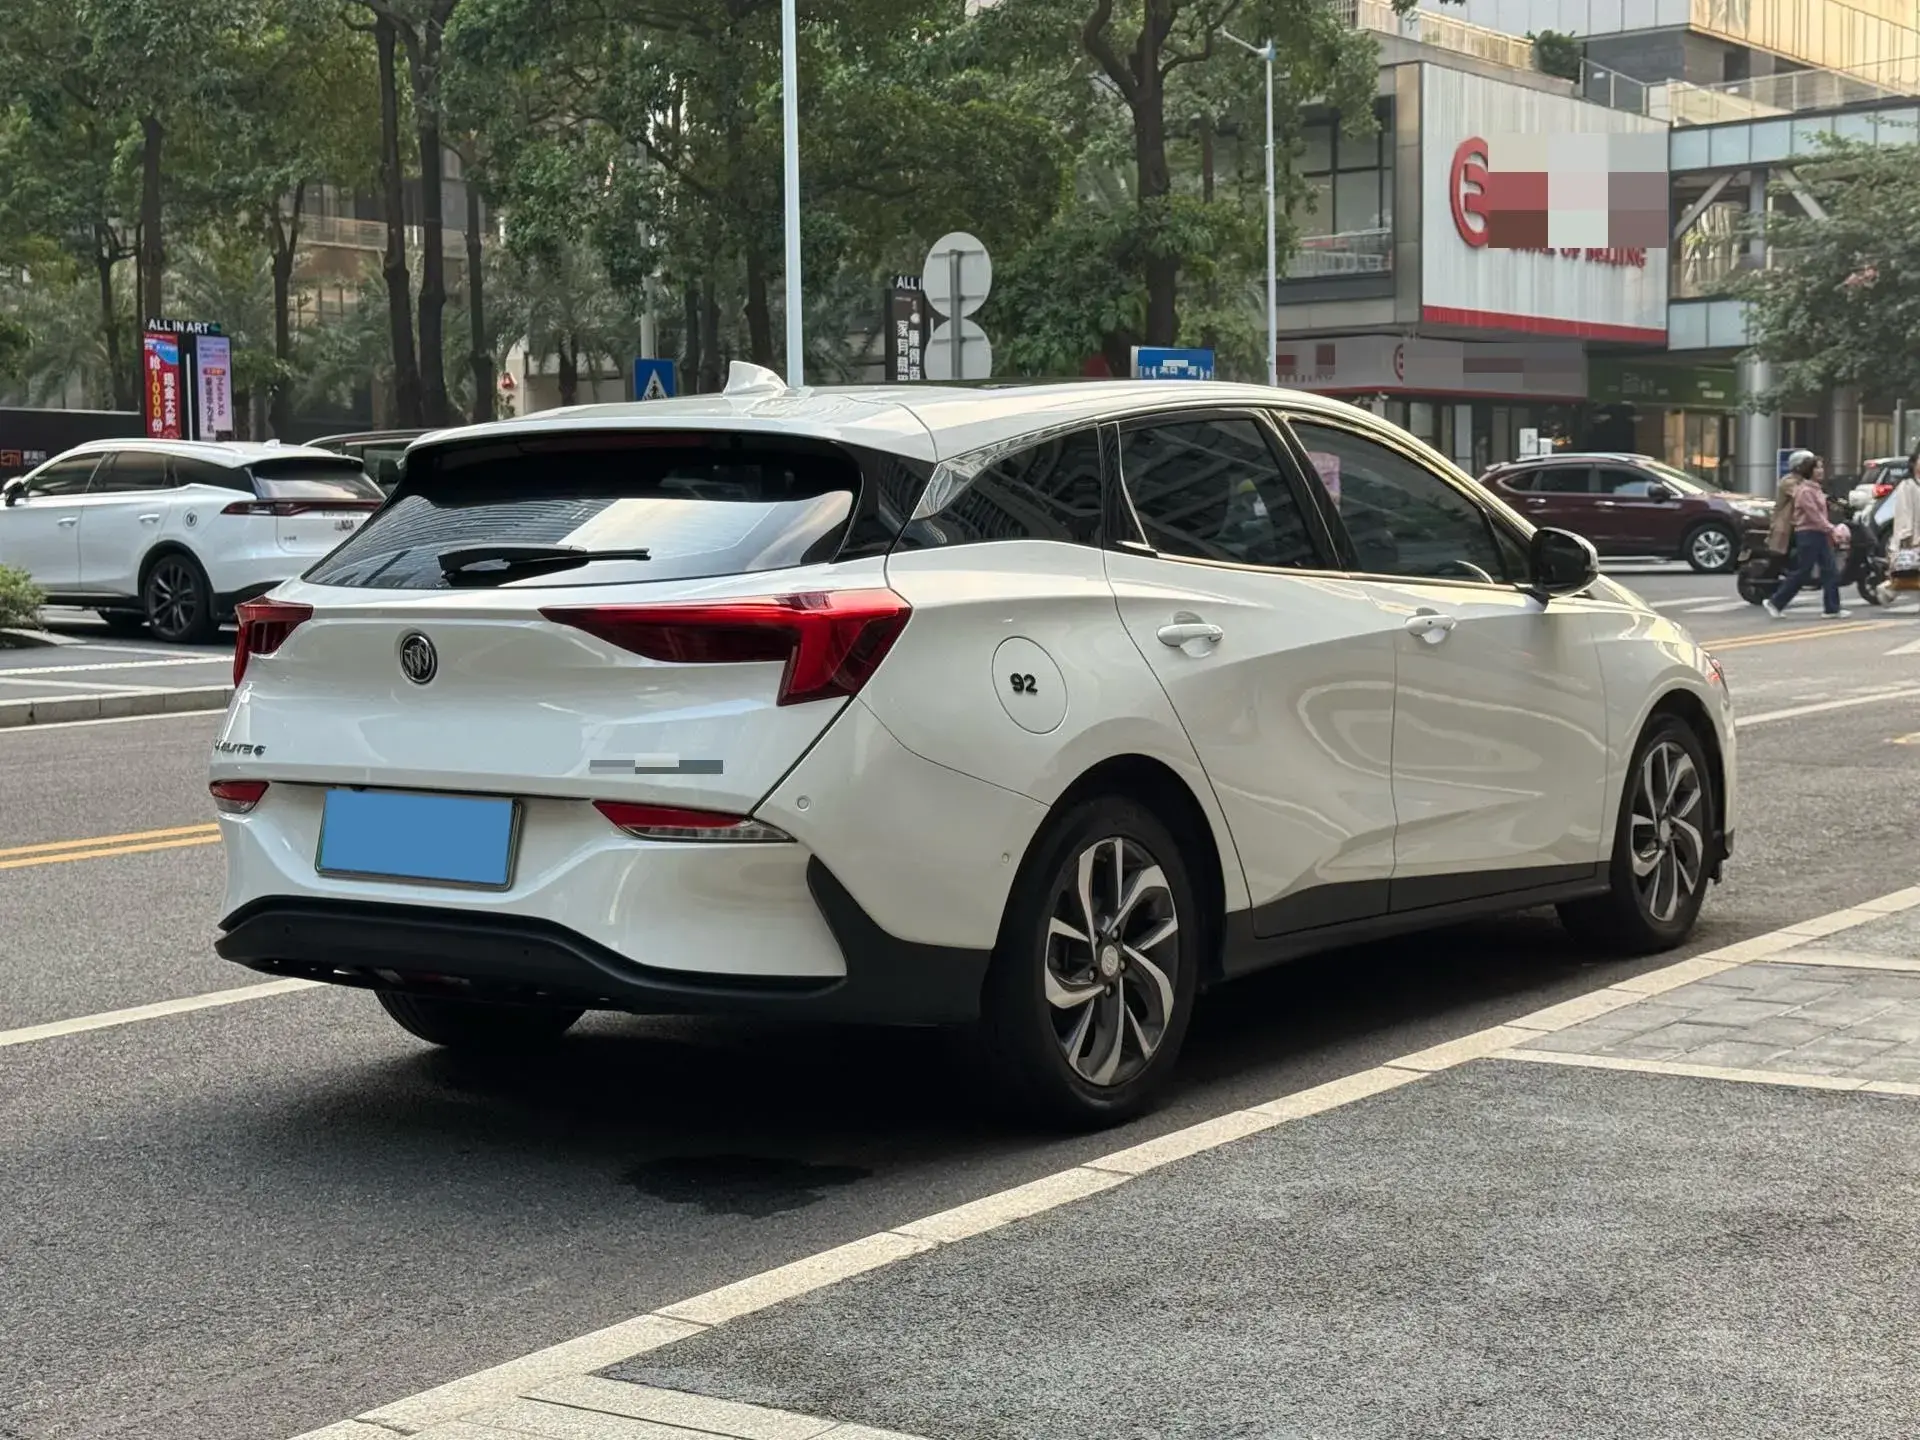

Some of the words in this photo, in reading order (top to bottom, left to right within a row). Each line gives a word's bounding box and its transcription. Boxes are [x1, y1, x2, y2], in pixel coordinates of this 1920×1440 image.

[896, 275, 917, 290] ALL
[148, 318, 171, 332] ALL
[172, 320, 184, 332] IN
[186, 321, 209, 334] ART
[1010, 672, 1038, 694] 92
